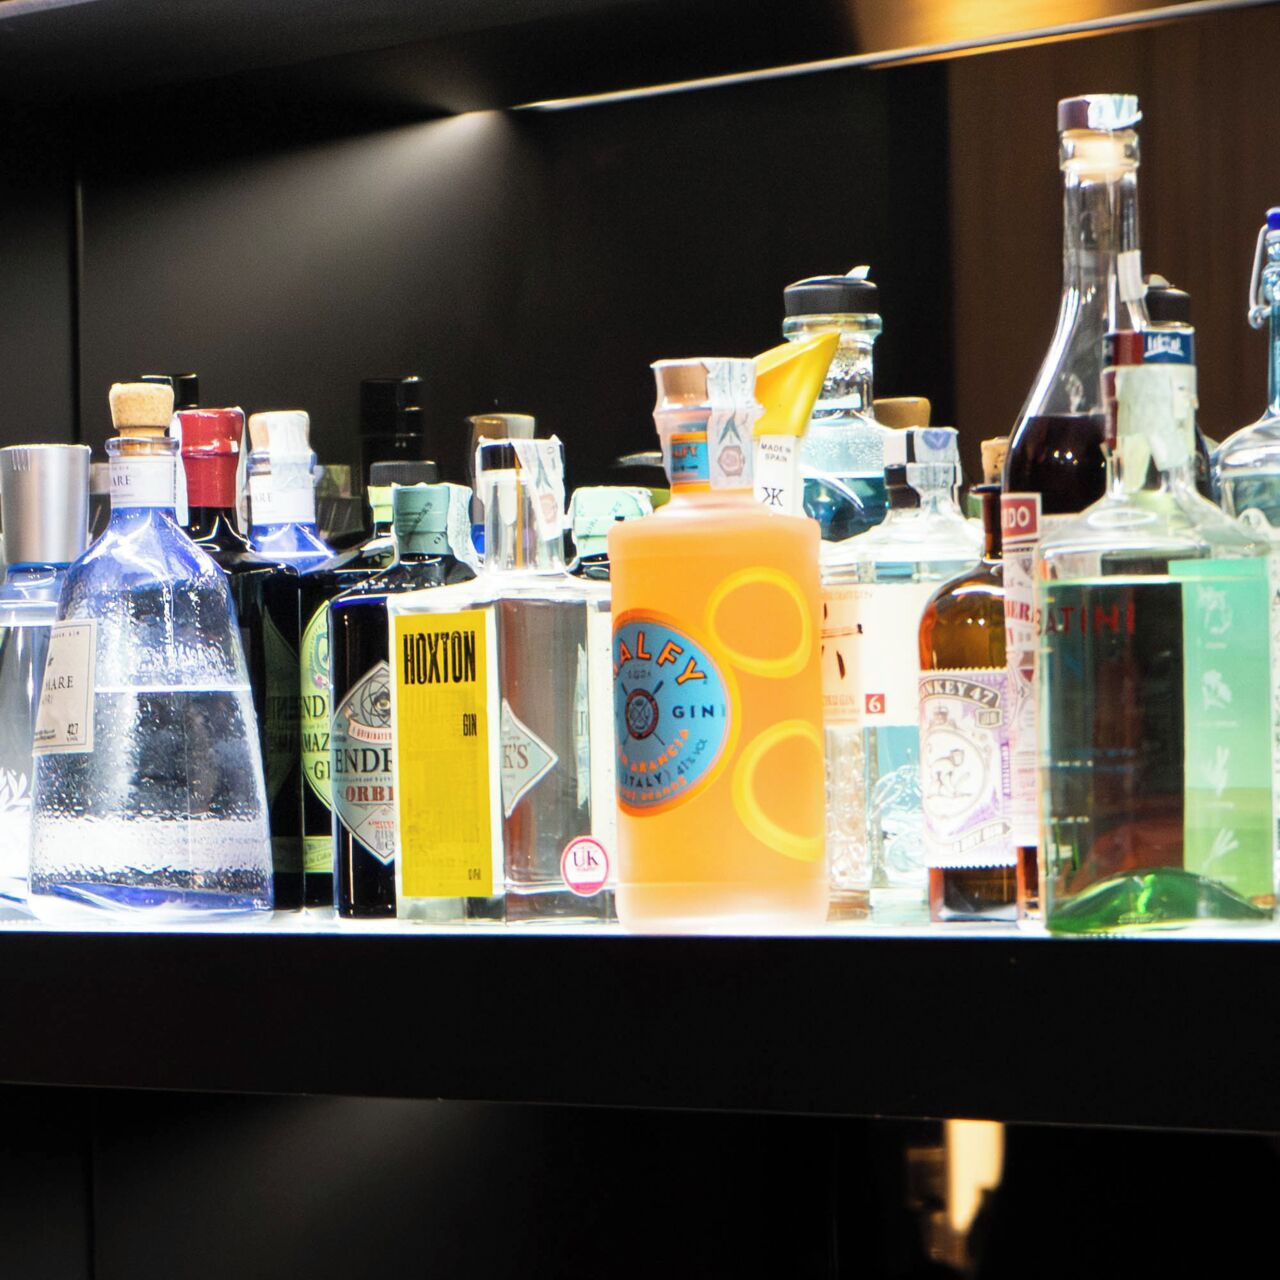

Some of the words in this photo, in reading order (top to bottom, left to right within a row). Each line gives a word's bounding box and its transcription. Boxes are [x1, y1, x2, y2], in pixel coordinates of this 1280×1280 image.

[403, 630, 477, 686] HOXTON
[868, 695, 881, 713] 6
[970, 683, 996, 706] 47
[671, 704, 716, 719] GIN
[463, 713, 478, 737] GIN
[573, 849, 600, 868] UK
